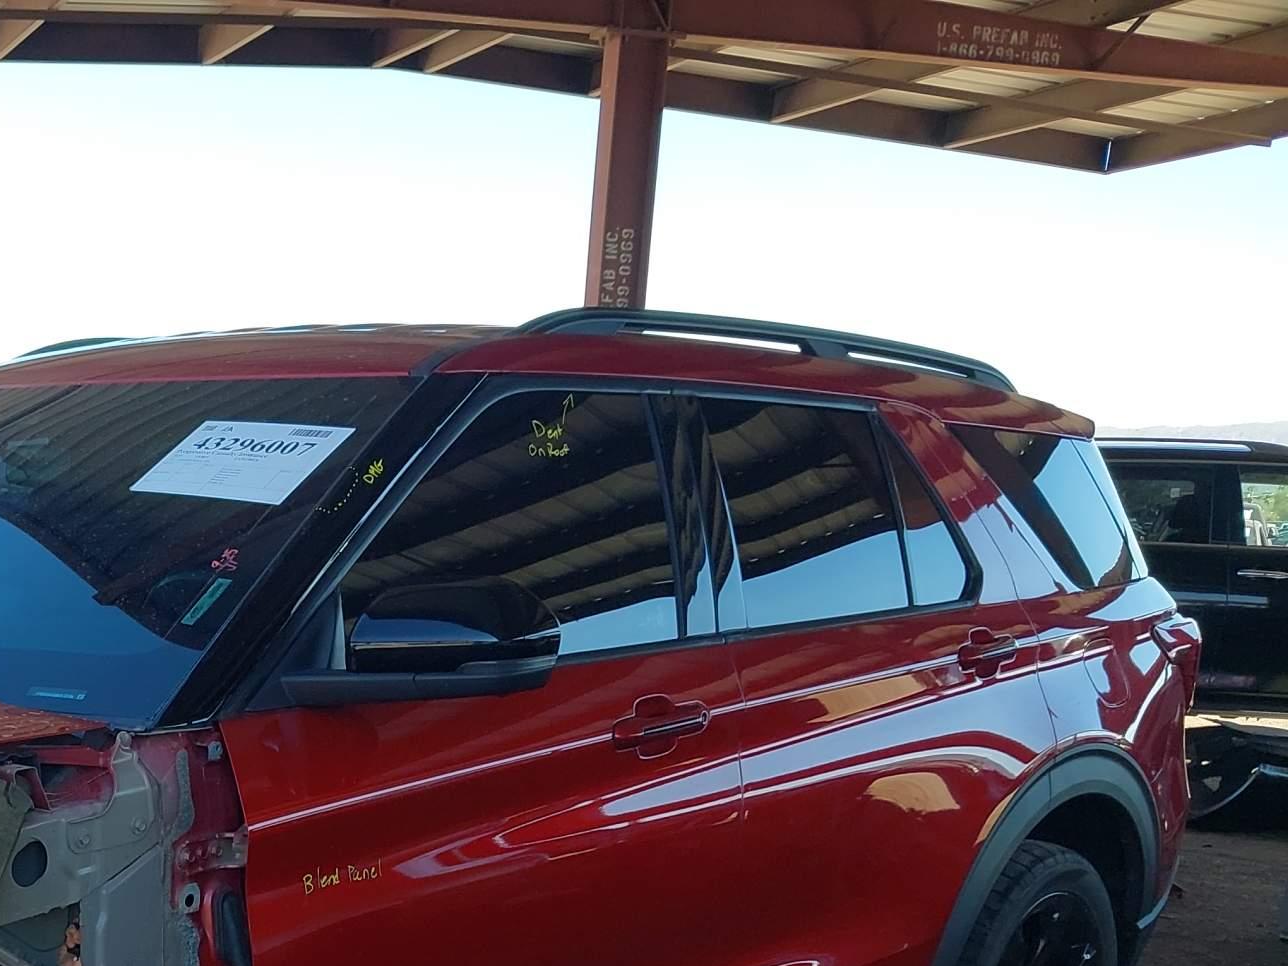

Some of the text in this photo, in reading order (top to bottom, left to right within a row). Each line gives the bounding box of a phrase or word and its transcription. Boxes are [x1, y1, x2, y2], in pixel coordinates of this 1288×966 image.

[936, 21, 965, 40] U.S.
[1035, 32, 1062, 50] INC.
[600, 226, 619, 307] FAB INC.
[532, 420, 562, 439] Dent
[193, 436, 318, 456] 43296007
[528, 444, 546, 456] On
[363, 459, 383, 484] DMG
[303, 858, 382, 895] Blend Panel
